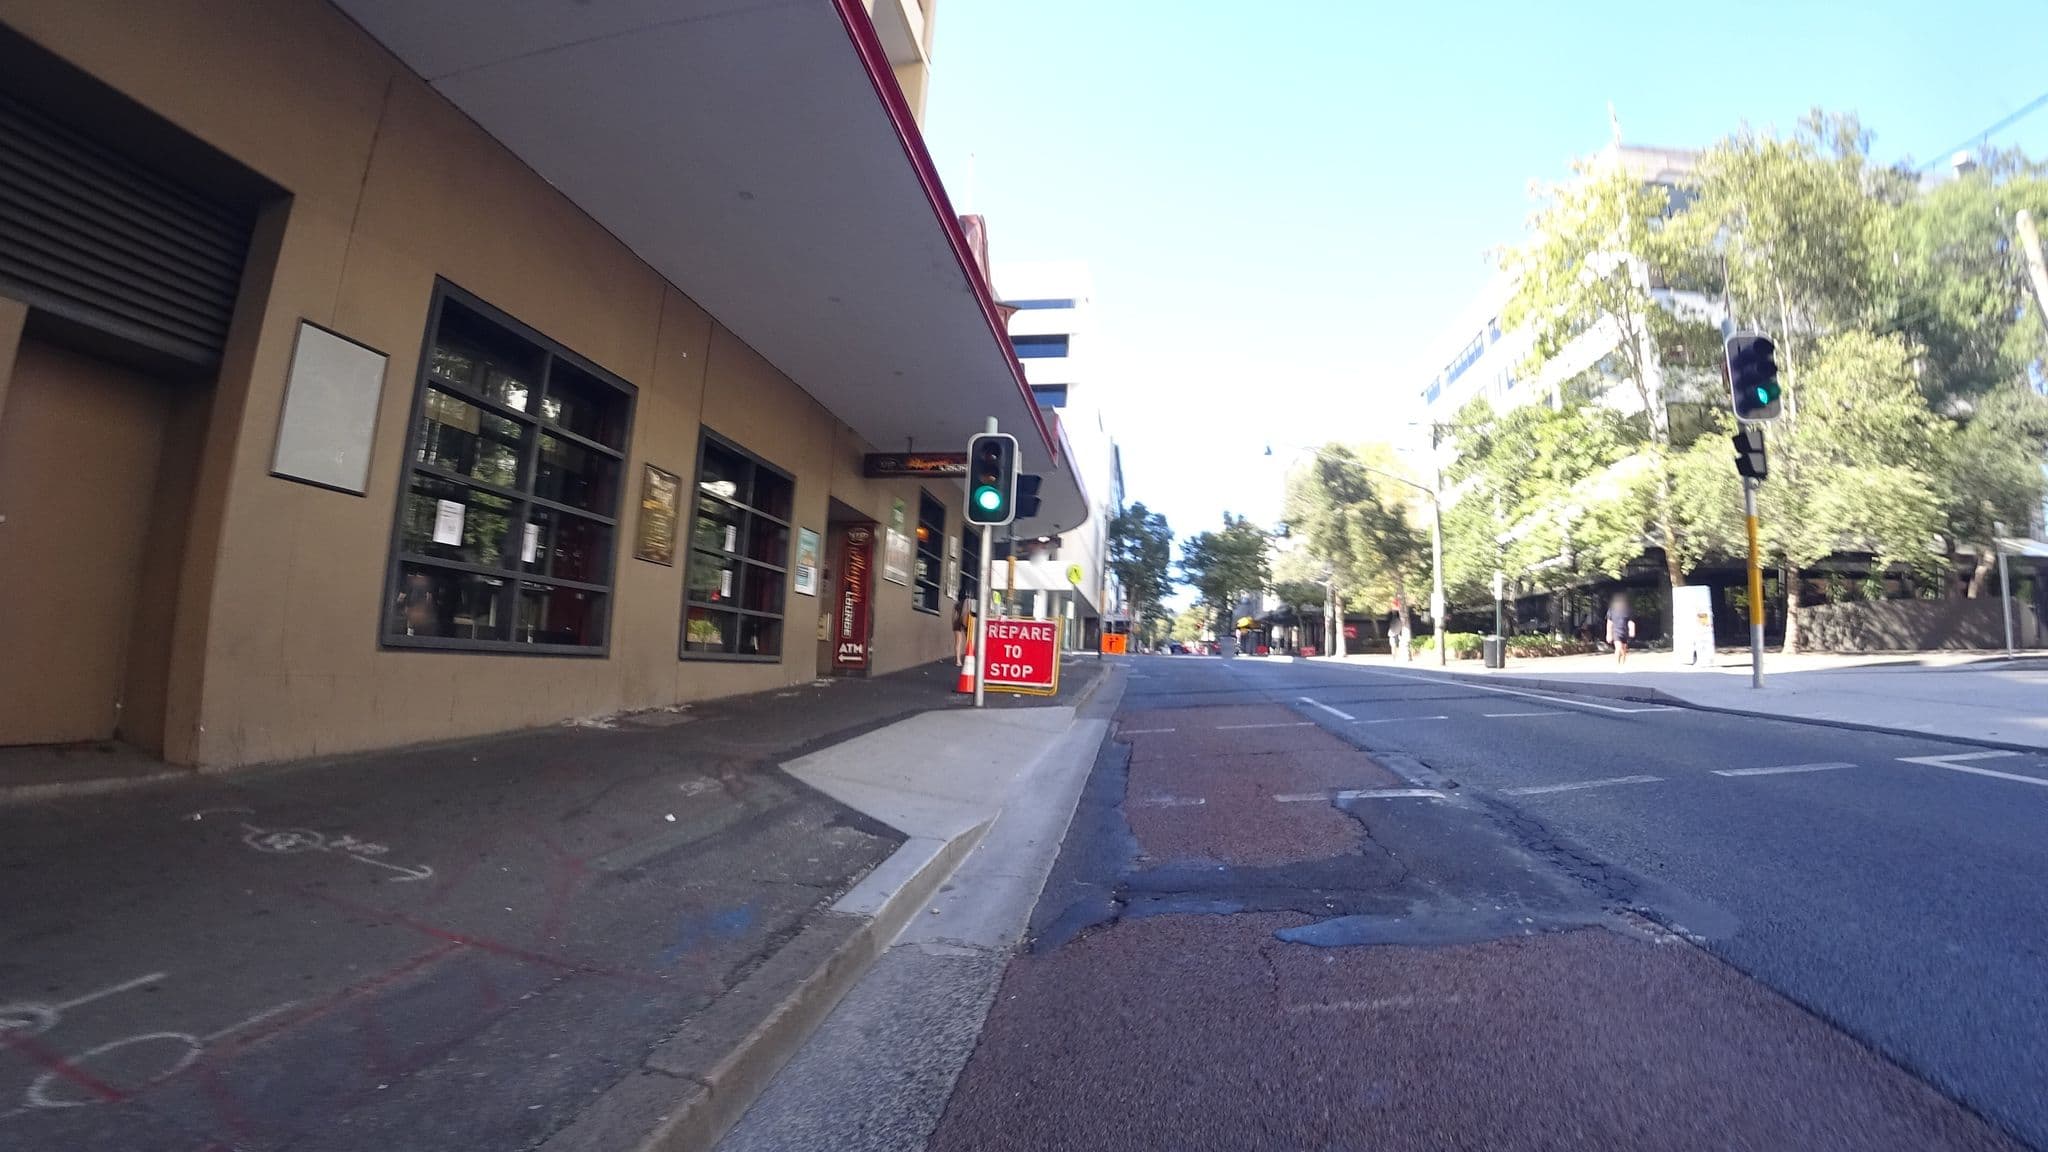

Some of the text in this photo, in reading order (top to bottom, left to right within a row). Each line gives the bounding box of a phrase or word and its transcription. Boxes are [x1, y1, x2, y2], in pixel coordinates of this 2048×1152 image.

[843, 591, 853, 636] LOUNGE
[985, 625, 1052, 641] REPARE
[838, 643, 863, 654] ATM
[1003, 644, 1022, 659] TO
[990, 662, 1034, 679] STOP
